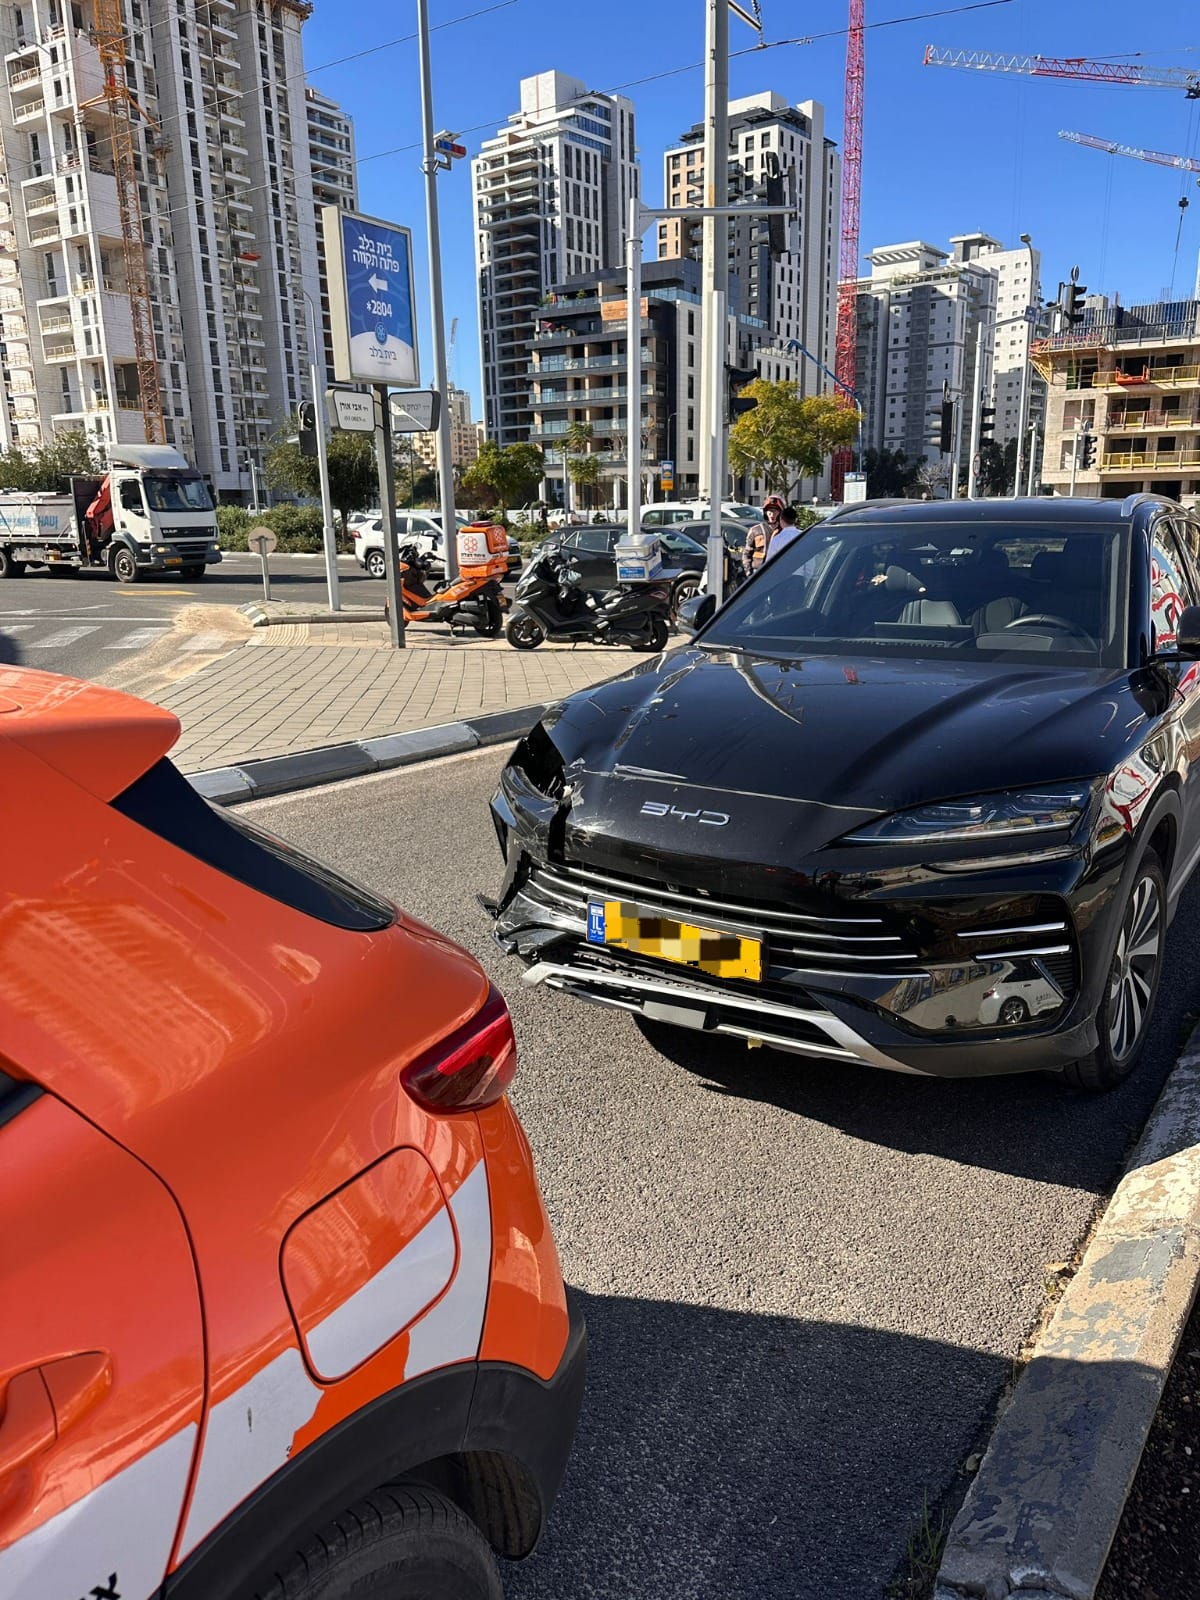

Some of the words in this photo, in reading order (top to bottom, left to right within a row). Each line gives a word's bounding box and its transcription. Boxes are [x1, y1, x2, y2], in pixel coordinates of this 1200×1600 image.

[358, 234, 375, 253] בלב
[377, 242, 392, 257] בית
[352, 249, 378, 270] תקווה
[379, 256, 400, 273] פתח
[369, 346, 384, 358] בלב
[384, 350, 397, 360] בית
[640, 801, 732, 826] BYD
[592, 915, 602, 931] IL
